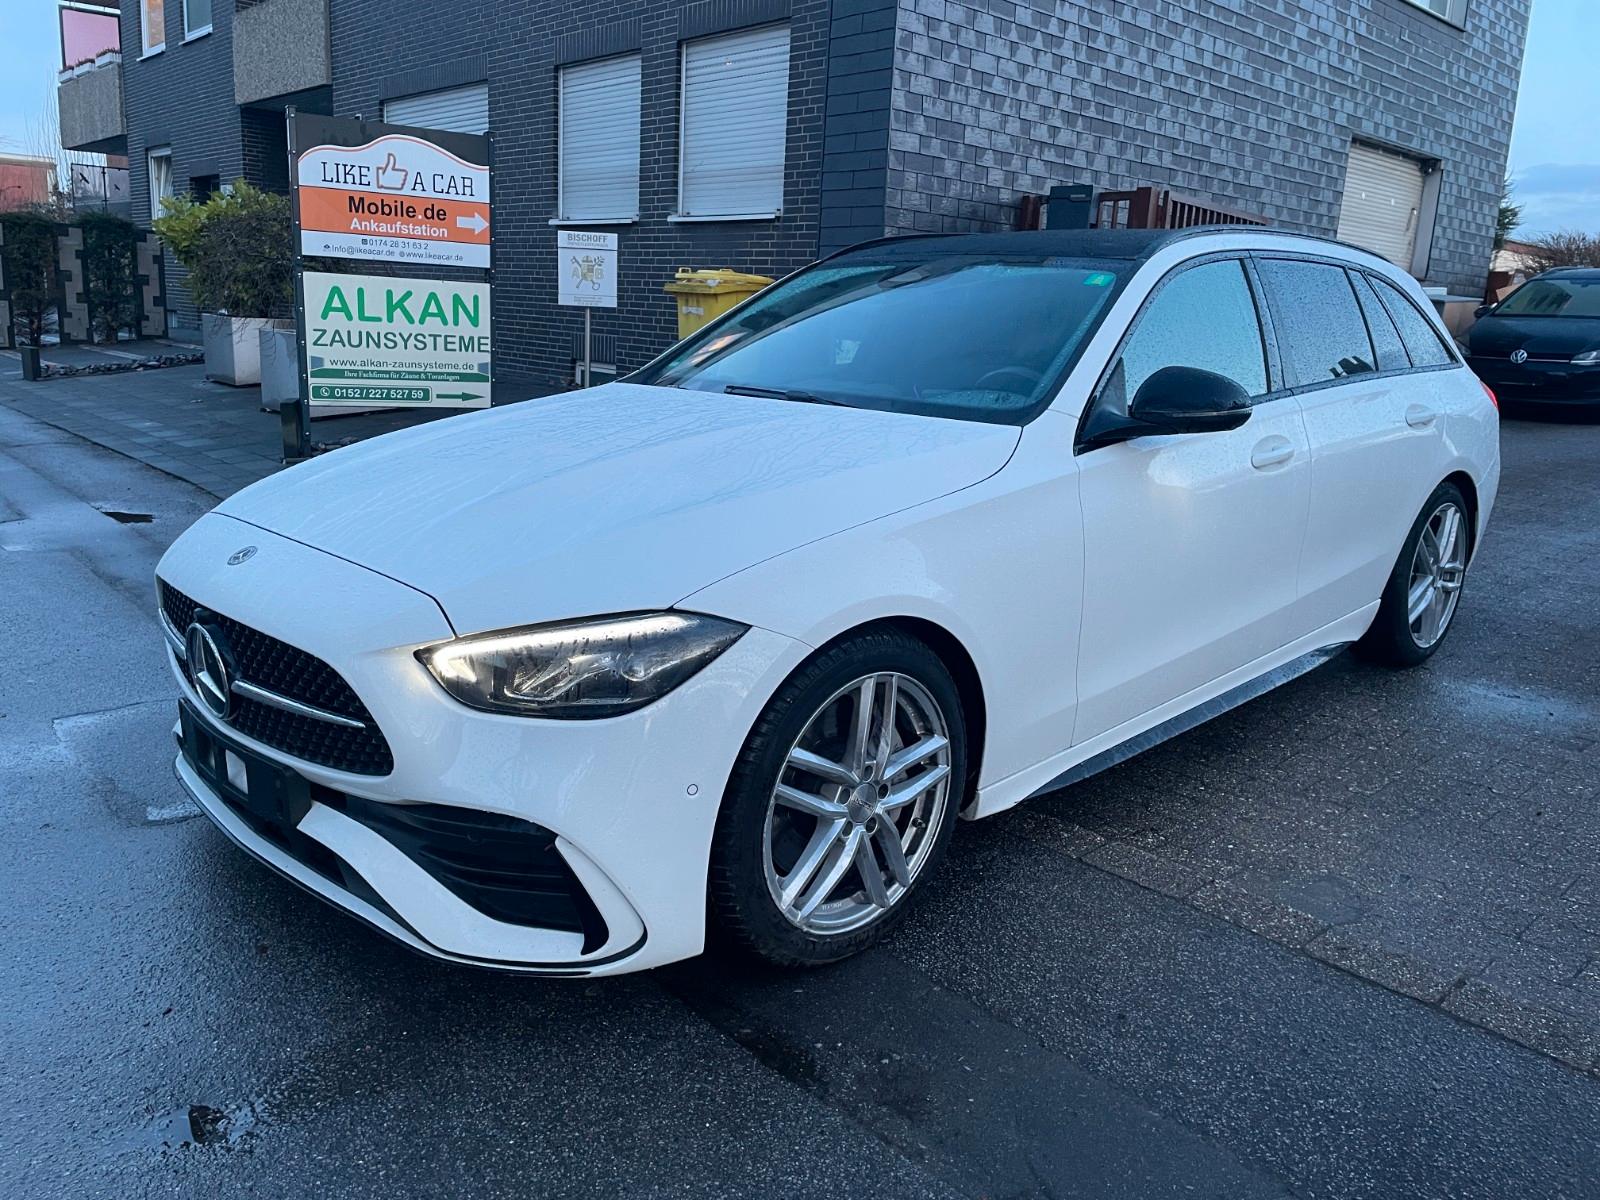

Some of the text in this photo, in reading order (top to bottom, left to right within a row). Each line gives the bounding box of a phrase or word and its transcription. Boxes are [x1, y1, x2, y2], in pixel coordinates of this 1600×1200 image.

[321, 161, 475, 197] LIKE A CAR
[348, 196, 447, 221] Mobile.de
[350, 217, 448, 238] Ankaufstation
[368, 238, 388, 248] 0174
[401, 241, 410, 249] 31
[423, 242, 429, 250] 2
[567, 232, 609, 243] BISCHOFF
[320, 285, 480, 328] ALKAN
[312, 328, 490, 353] ZAUNSYSTEME
[329, 357, 475, 371] www.alkan-zaunsysteme.de
[359, 371, 390, 379] Fachfirma
[427, 373, 460, 381] Toranlagen
[334, 388, 361, 398] 0152
[368, 389, 388, 399] 227
[390, 390, 410, 399] 527
[411, 390, 424, 399] 59
